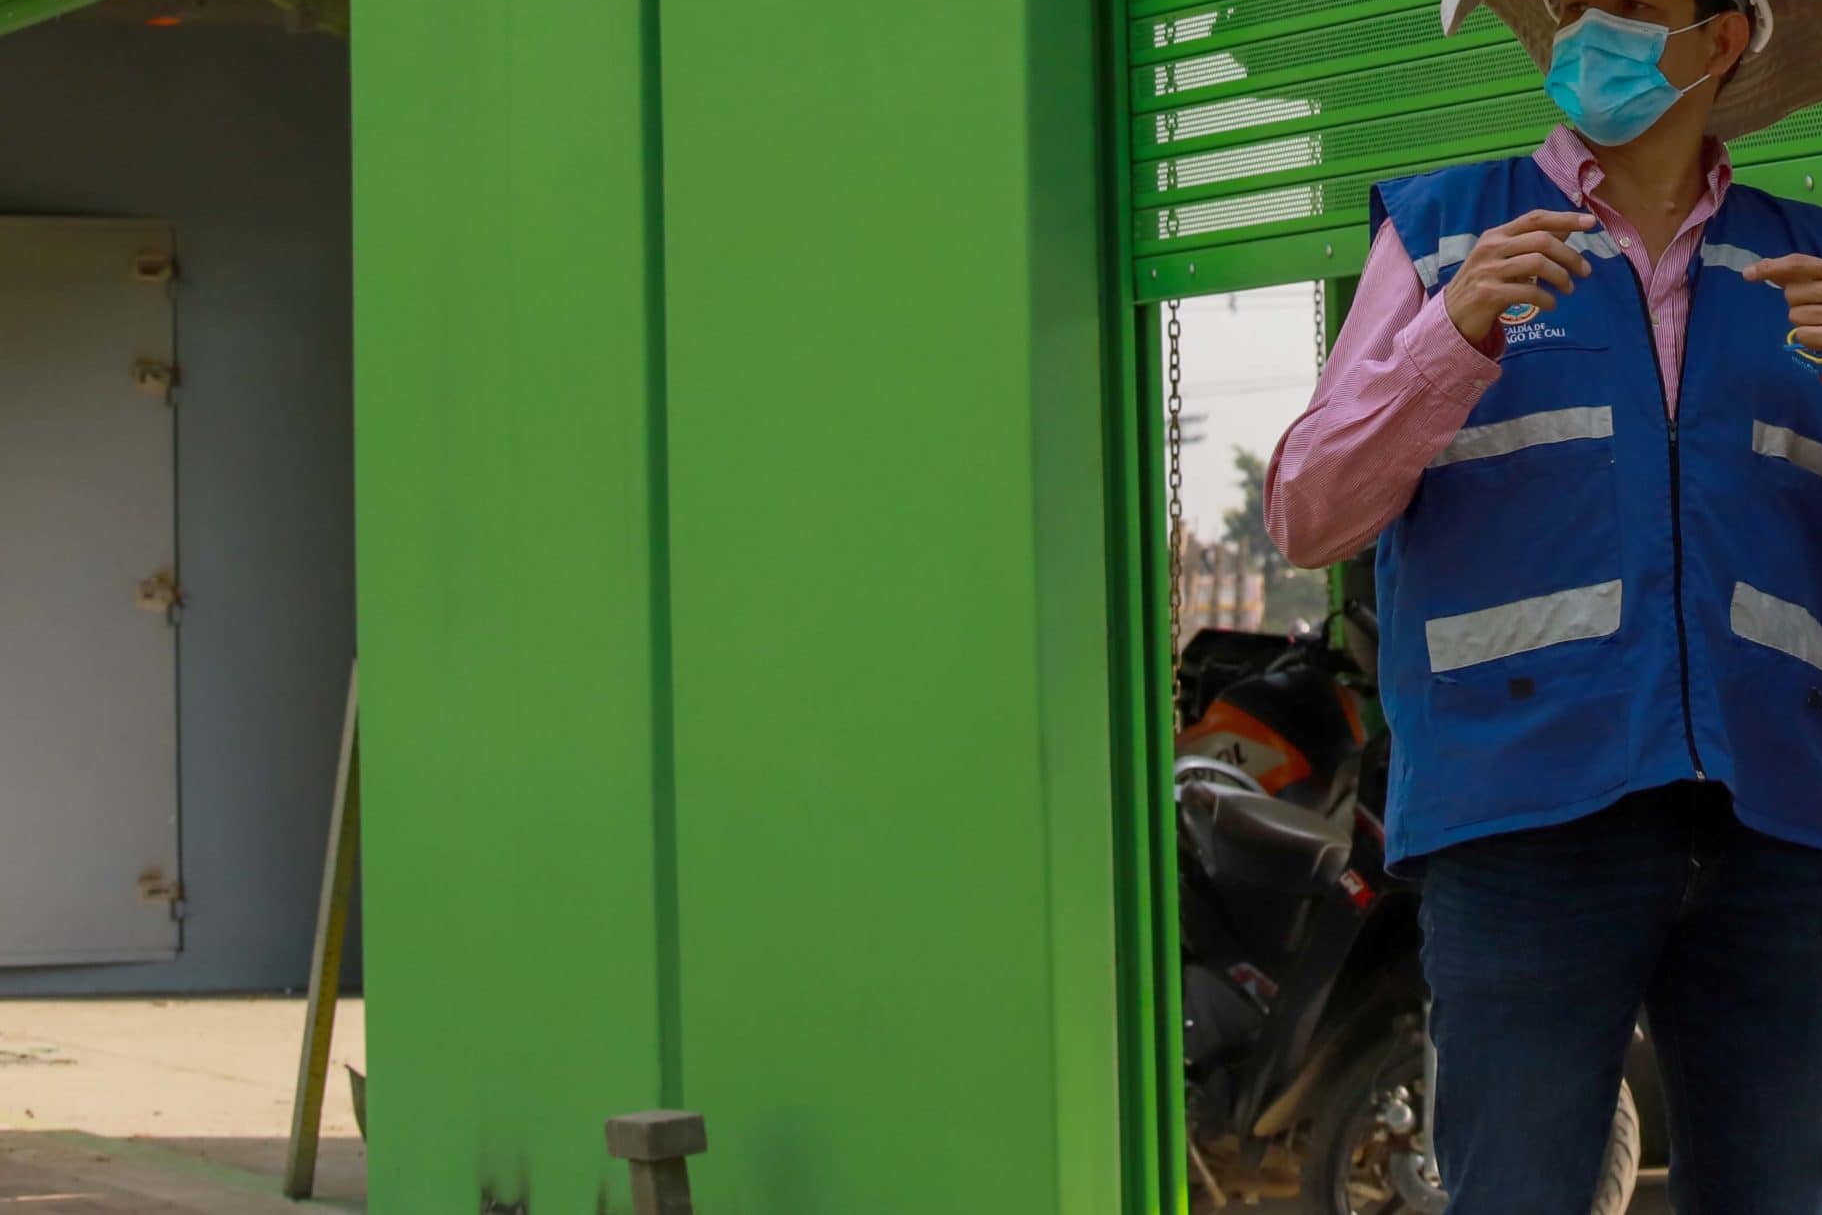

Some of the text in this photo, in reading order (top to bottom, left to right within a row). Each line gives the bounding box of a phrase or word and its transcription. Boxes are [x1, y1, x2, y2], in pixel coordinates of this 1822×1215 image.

[1534, 322, 1545, 331] DE
[1529, 330, 1542, 340] DE
[1544, 327, 1566, 338] CALI
